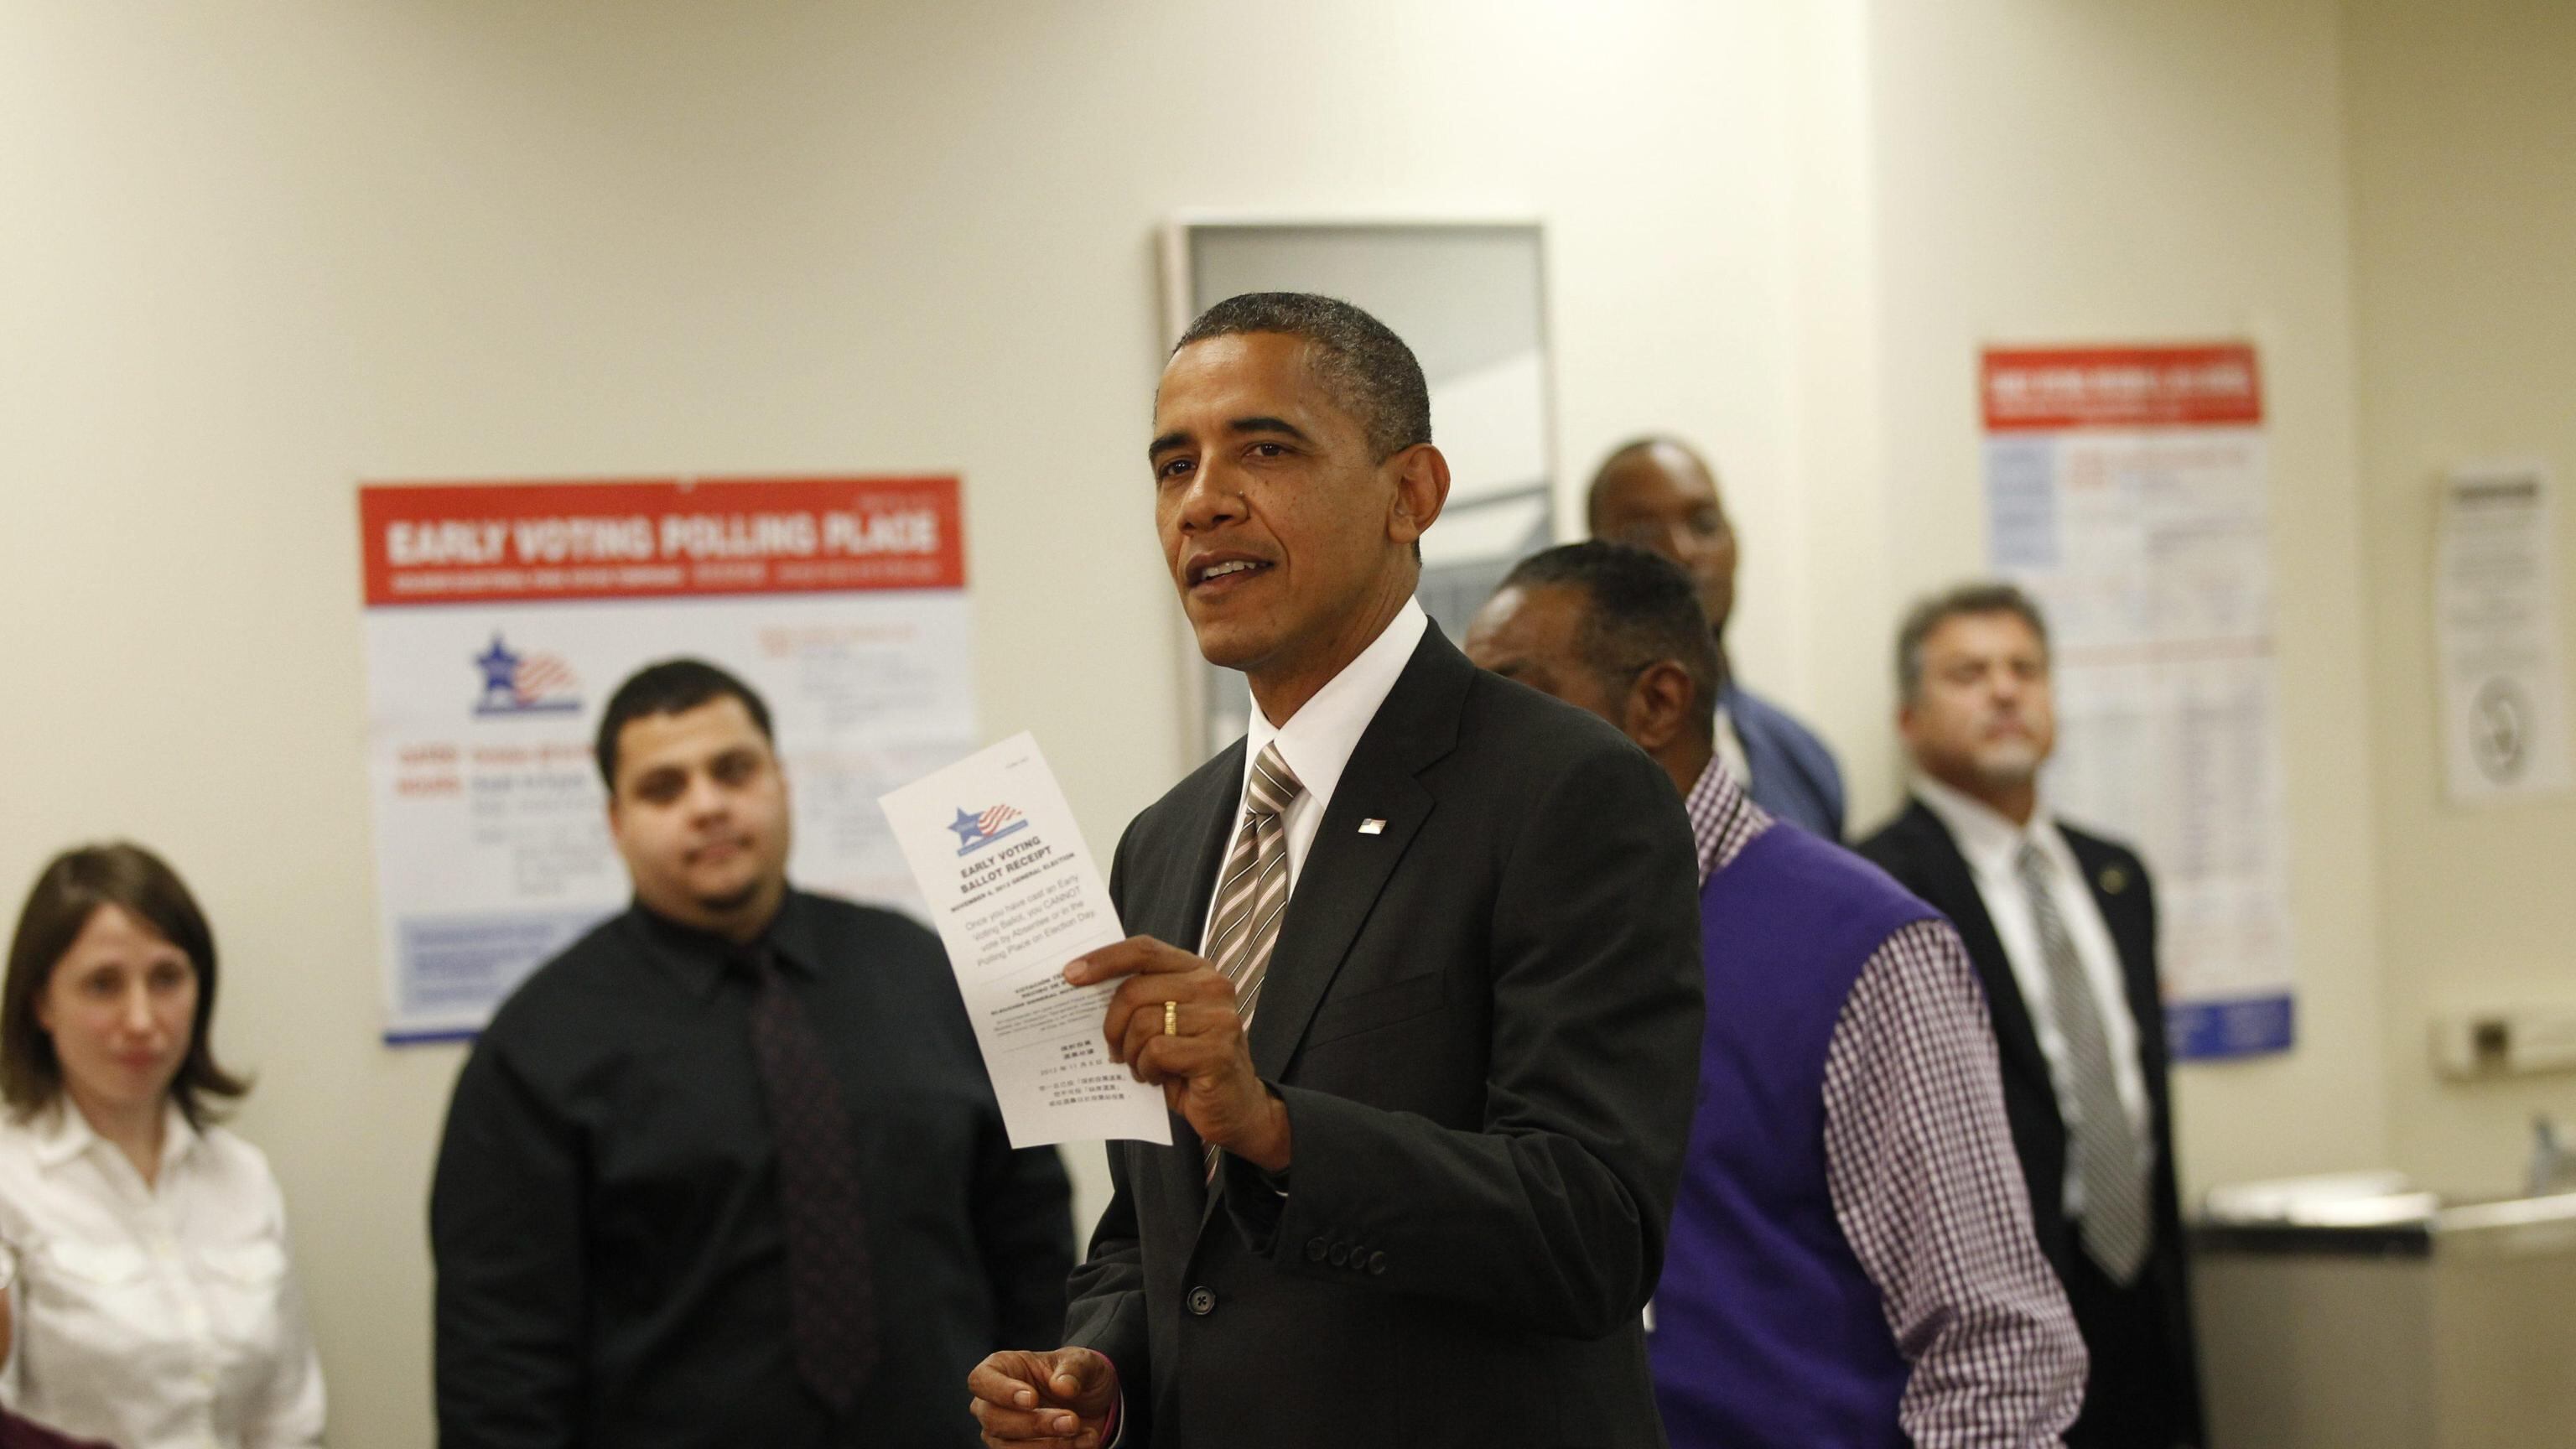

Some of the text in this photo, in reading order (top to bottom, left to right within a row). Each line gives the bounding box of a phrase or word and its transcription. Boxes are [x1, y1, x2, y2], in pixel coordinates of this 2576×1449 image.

[387, 508, 937, 567] EARLY VOTING POLLING PLACE
[960, 835, 1041, 879] EARLY VOTING
[960, 845, 1052, 894] BALLOT RECEIPT
[965, 874, 1079, 931] Once you have cast an Early
[974, 926, 1000, 941] Voting
[1027, 906, 1043, 918] you
[1043, 886, 1080, 909] CANNOT
[981, 900, 1084, 952] vote by Absentee or in the
[977, 950, 1007, 967] Polling
[1006, 938, 1031, 954] Place
[1032, 932, 1043, 943] on
[1044, 917, 1077, 937] Election
